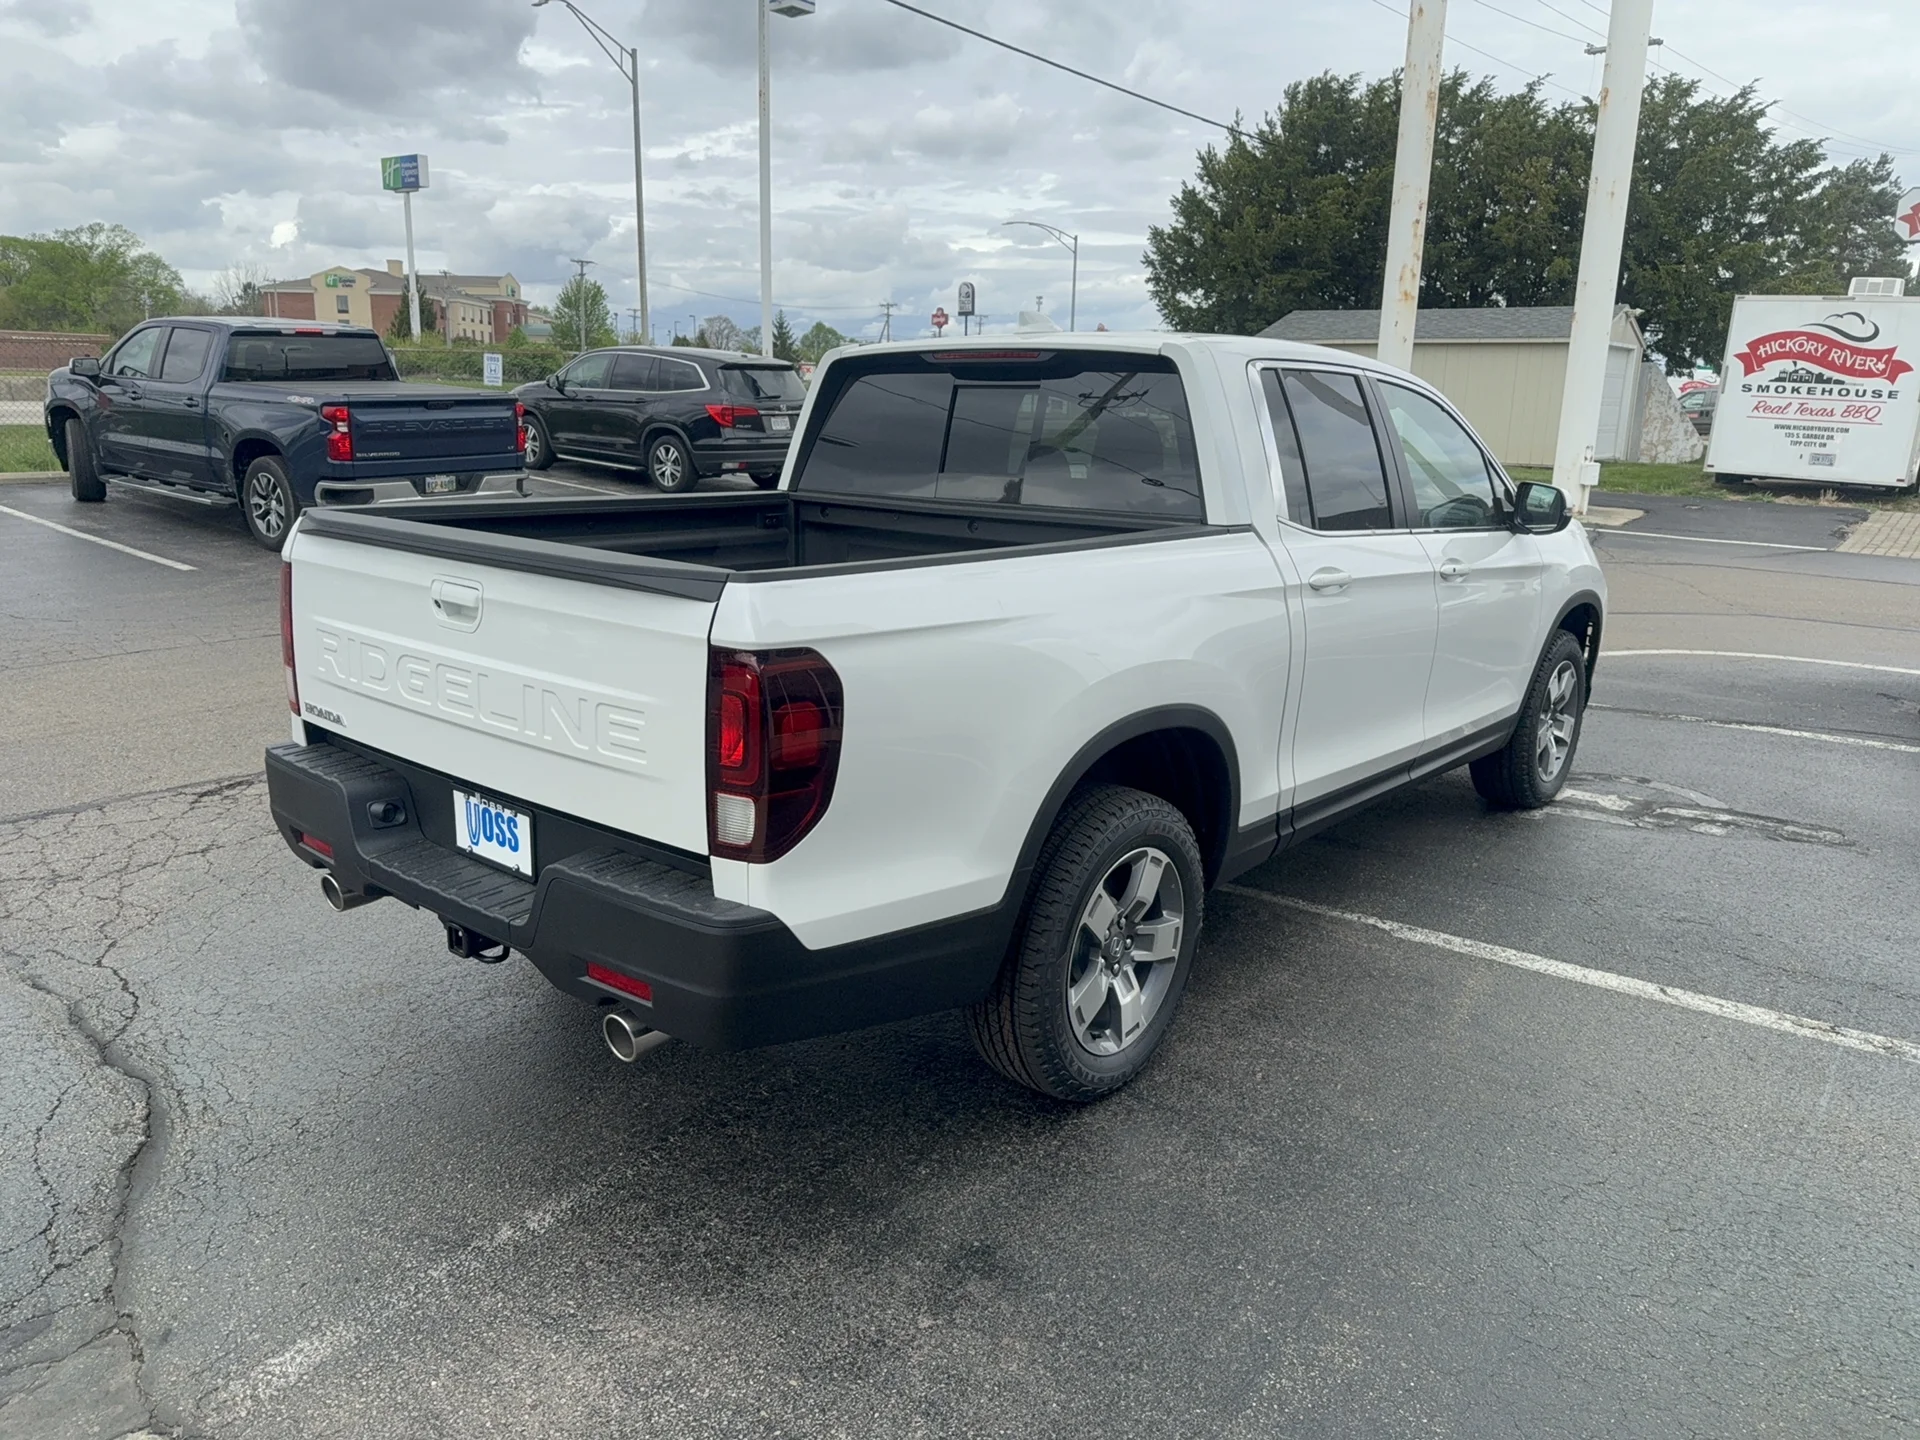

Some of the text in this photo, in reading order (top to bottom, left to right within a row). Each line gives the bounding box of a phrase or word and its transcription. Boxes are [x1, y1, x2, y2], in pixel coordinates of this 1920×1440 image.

[1757, 336, 1881, 373] HICKORY RIVER
[1741, 383, 1899, 399] SMOKEHOUSE
[1751, 400, 1882, 422] Real Texas BBQ
[1774, 424, 1850, 433] WWW.HICKORYRIVER.COM
[315, 628, 647, 764] RIDGELINE
[303, 702, 346, 728] HONDA
[465, 800, 519, 853] VOSS
